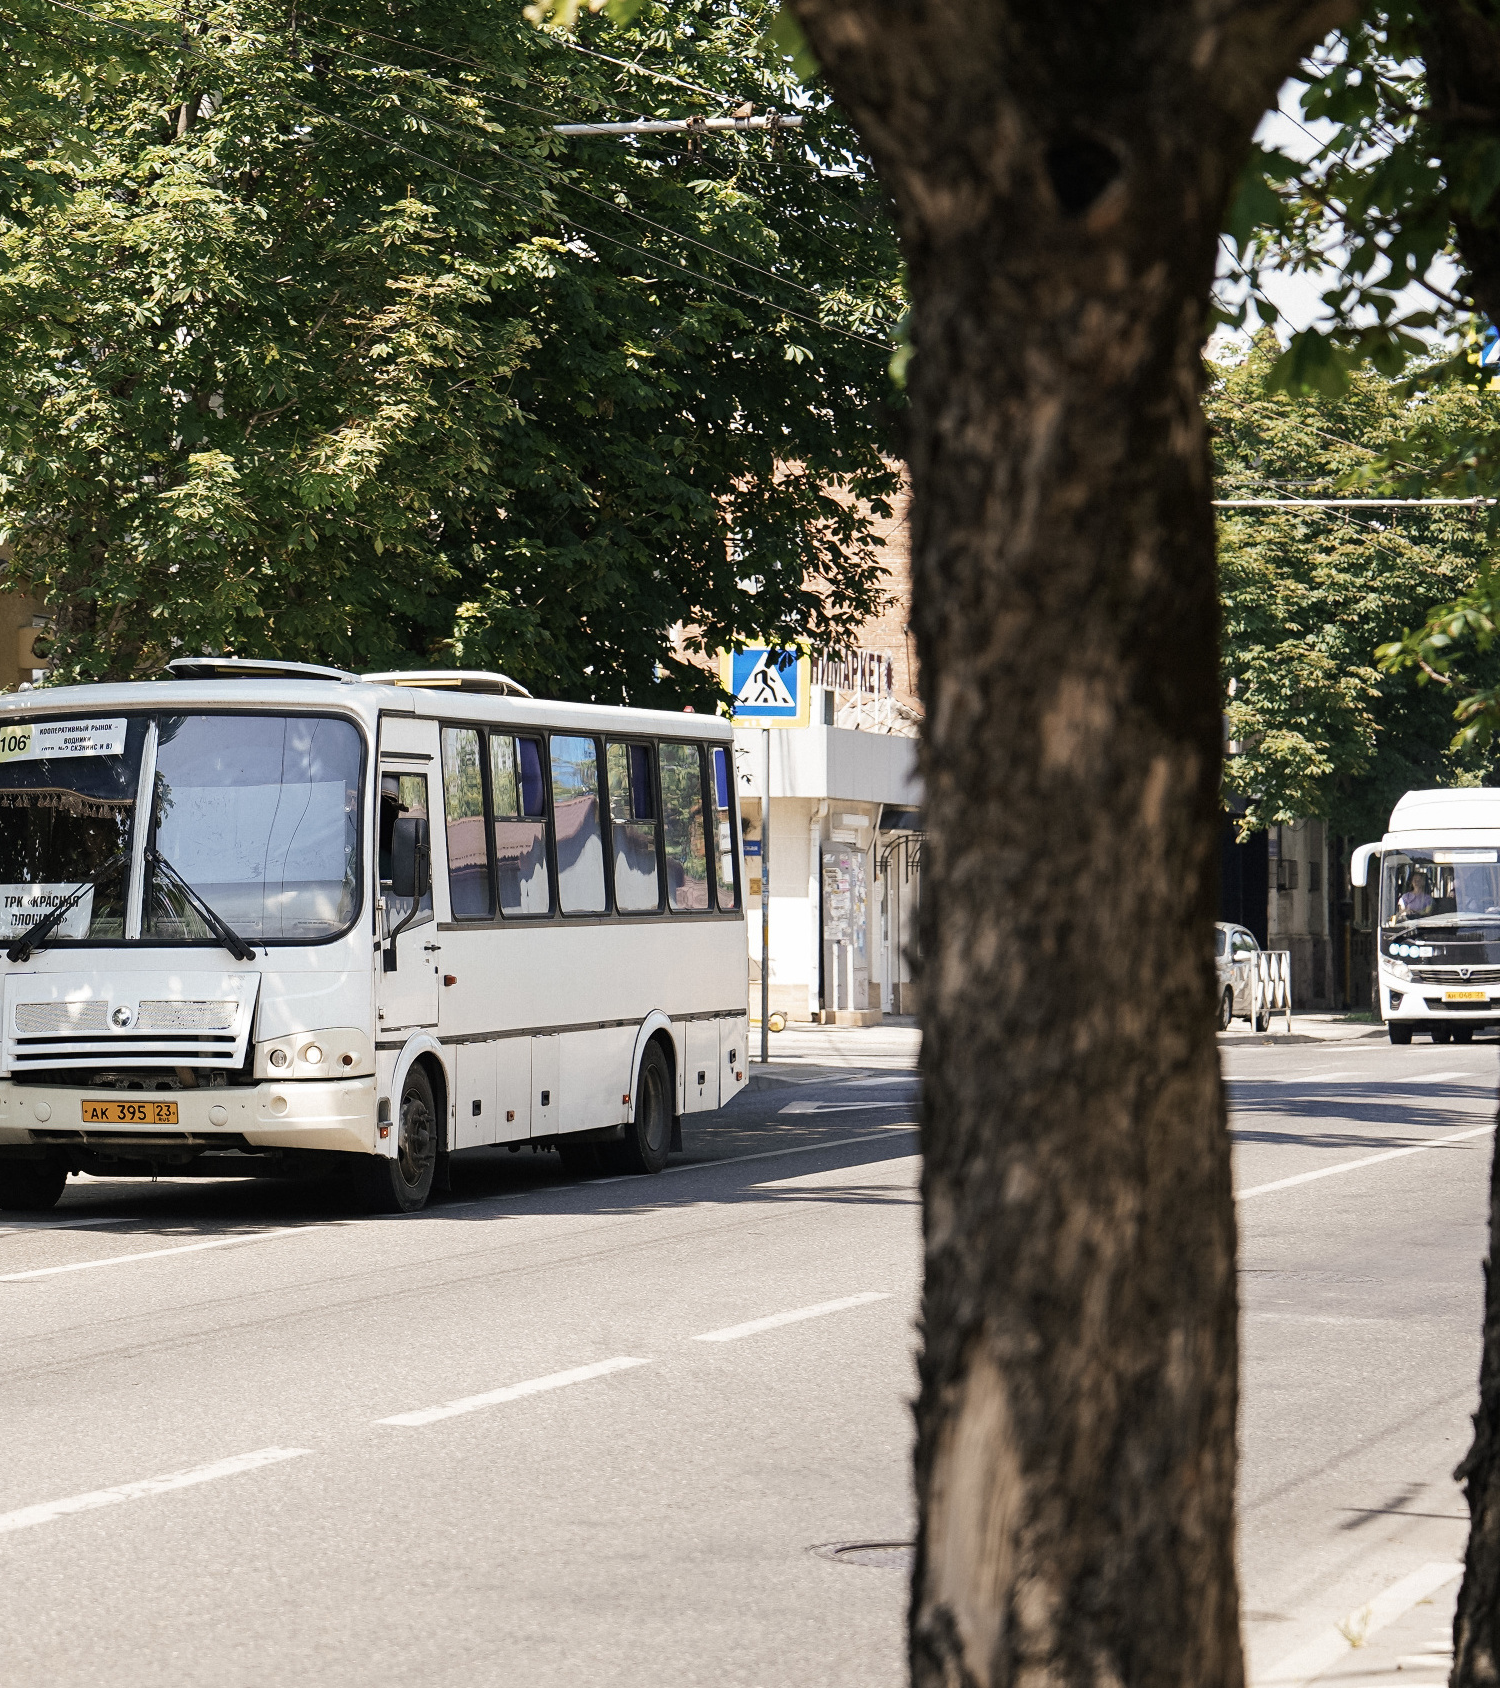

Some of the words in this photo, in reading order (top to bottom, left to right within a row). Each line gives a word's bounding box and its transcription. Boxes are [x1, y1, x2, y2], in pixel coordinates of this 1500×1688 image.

[40, 724, 88, 735] КООПЕРАТИВНЫЙ
[90, 723, 113, 732] РЫНОК
[63, 736, 92, 745] ВОДНИКИ
[5, 896, 23, 908] ТРК
[27, 896, 80, 907] «КРАСНАЯ
[117, 1104, 147, 1121] 395
[155, 1104, 171, 1117] 23
